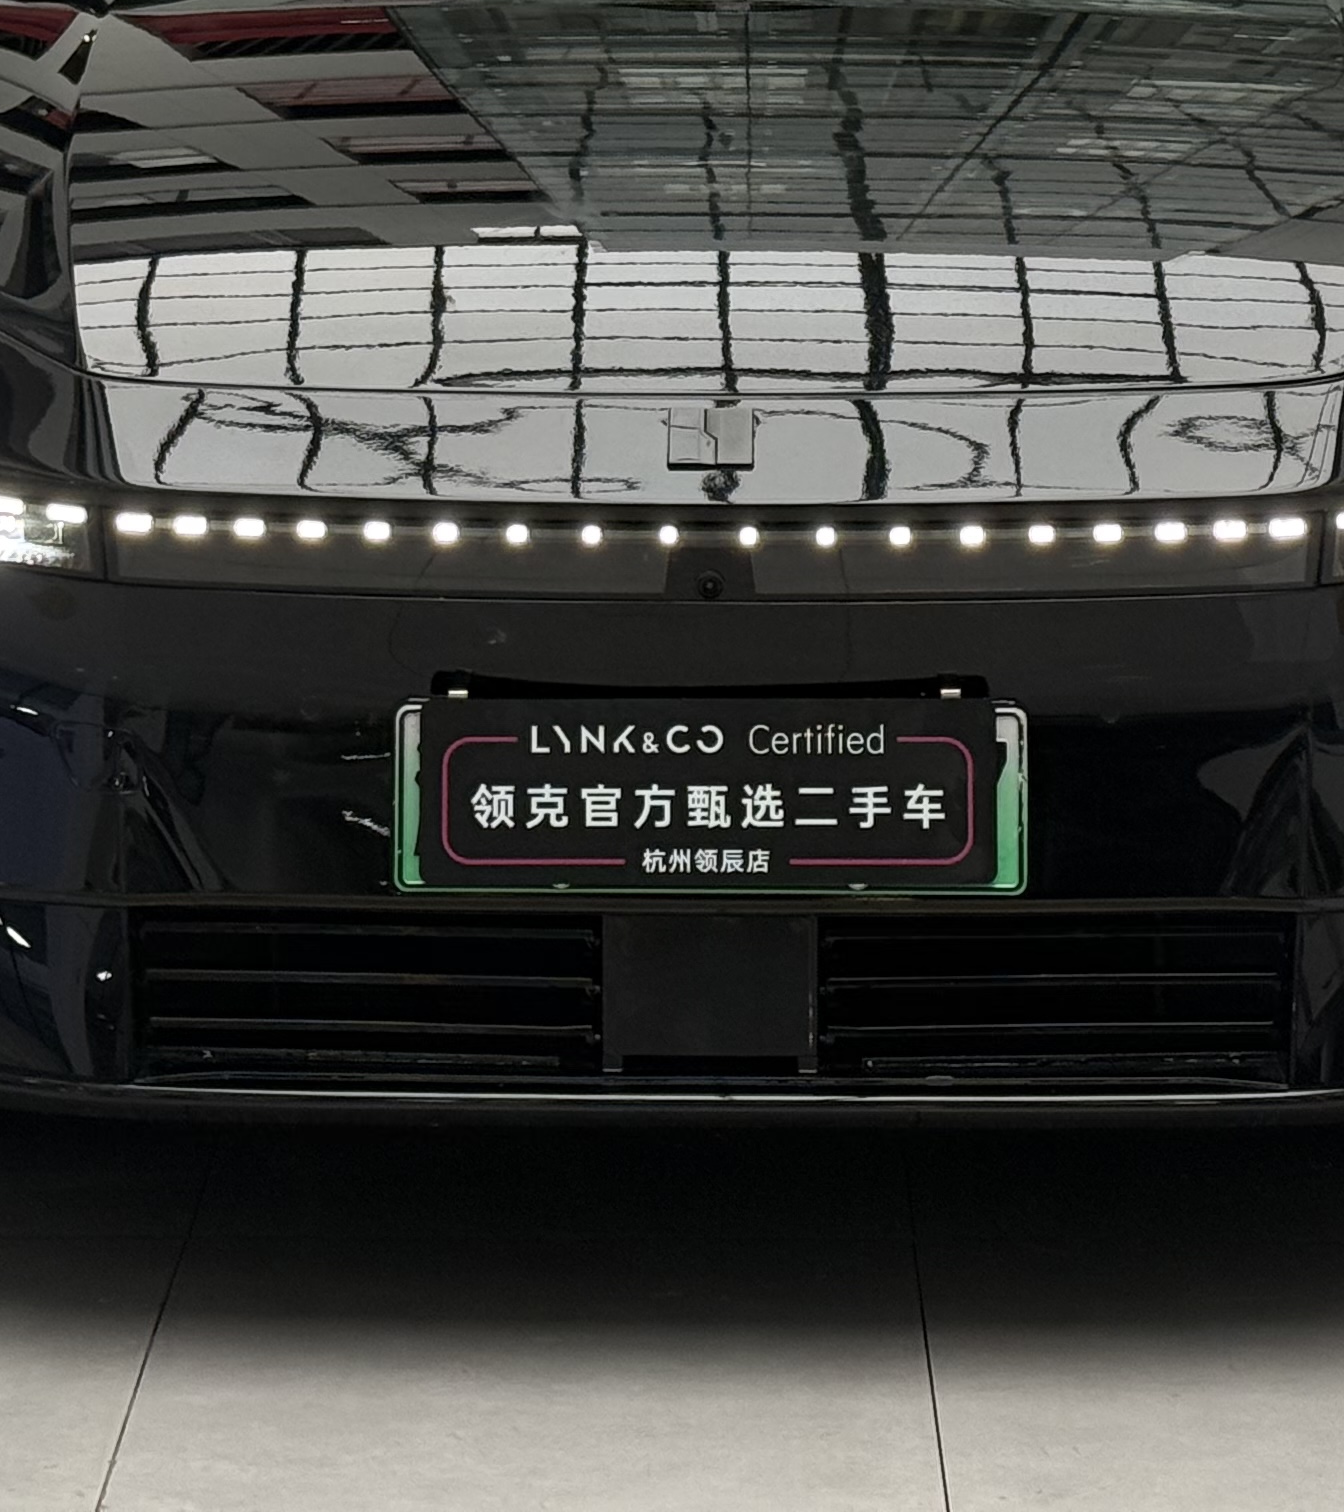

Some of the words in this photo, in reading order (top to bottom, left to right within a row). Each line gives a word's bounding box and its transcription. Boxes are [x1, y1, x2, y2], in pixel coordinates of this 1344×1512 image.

[530, 724, 725, 755] LYNK&CO
[748, 724, 886, 756] Certified
[470, 783, 948, 831] 领克官方甄选二手车
[642, 849, 771, 875] 杭州领辰店
